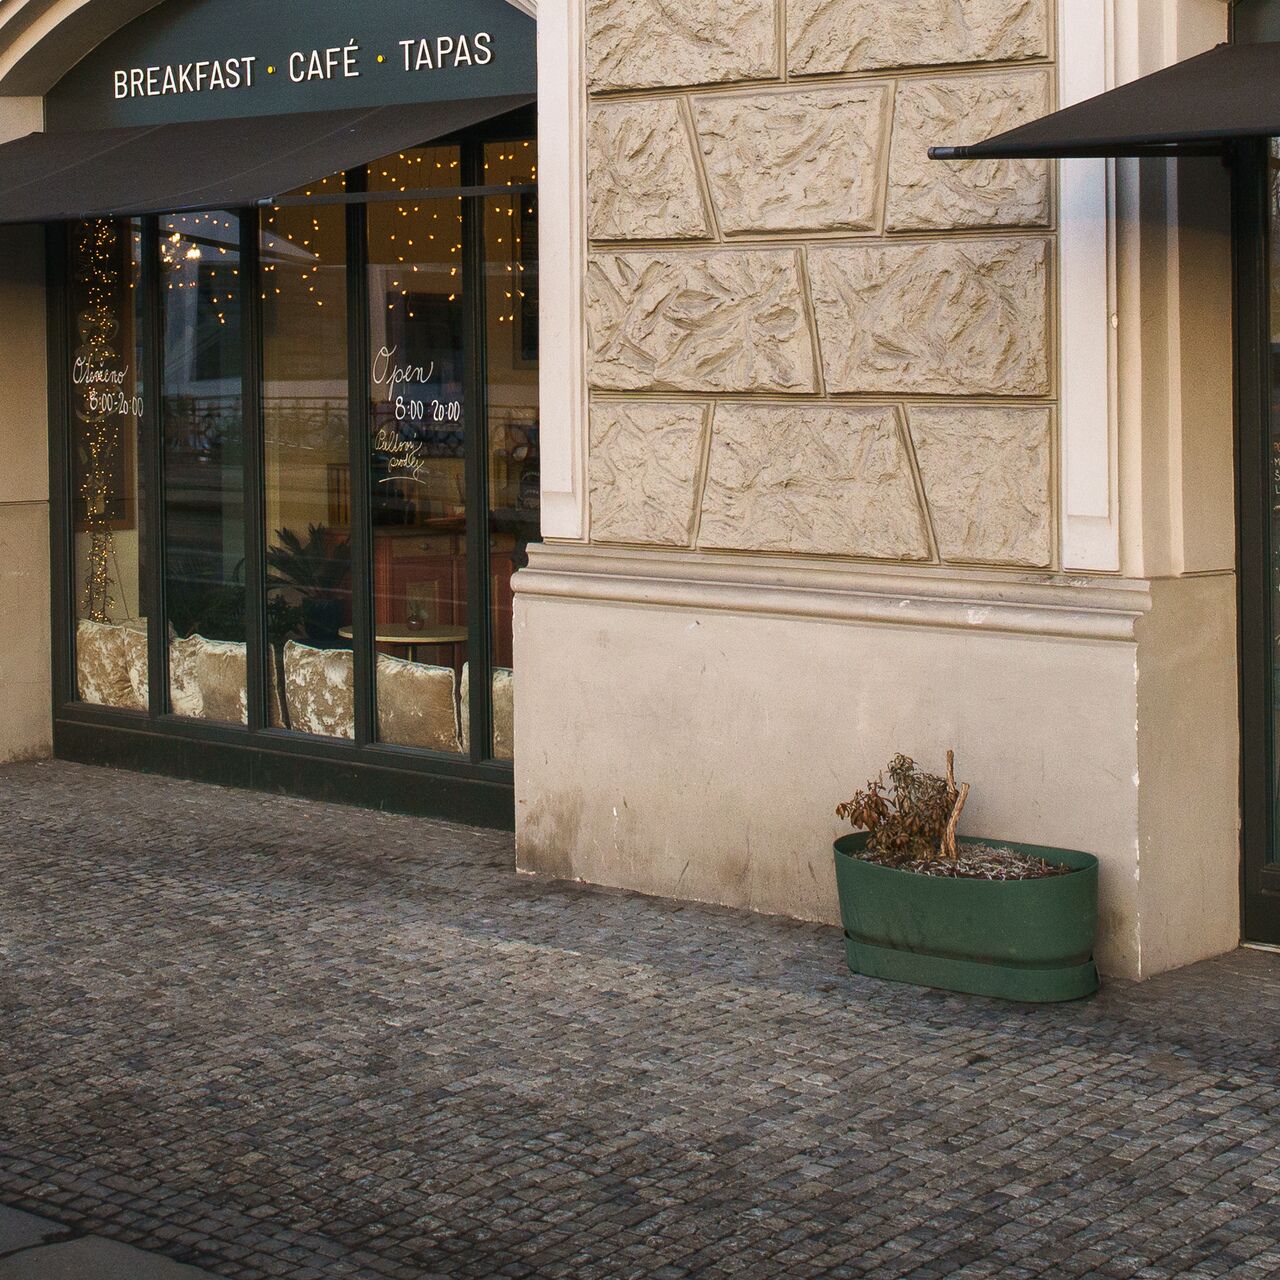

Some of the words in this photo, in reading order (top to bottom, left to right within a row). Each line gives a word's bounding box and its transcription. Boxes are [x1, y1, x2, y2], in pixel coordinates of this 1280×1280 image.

[113, 56, 256, 100] BREAKFAST
[288, 38, 360, 83] CAFÉ
[398, 32, 493, 72] TAPAS
[372, 344, 434, 402] Open
